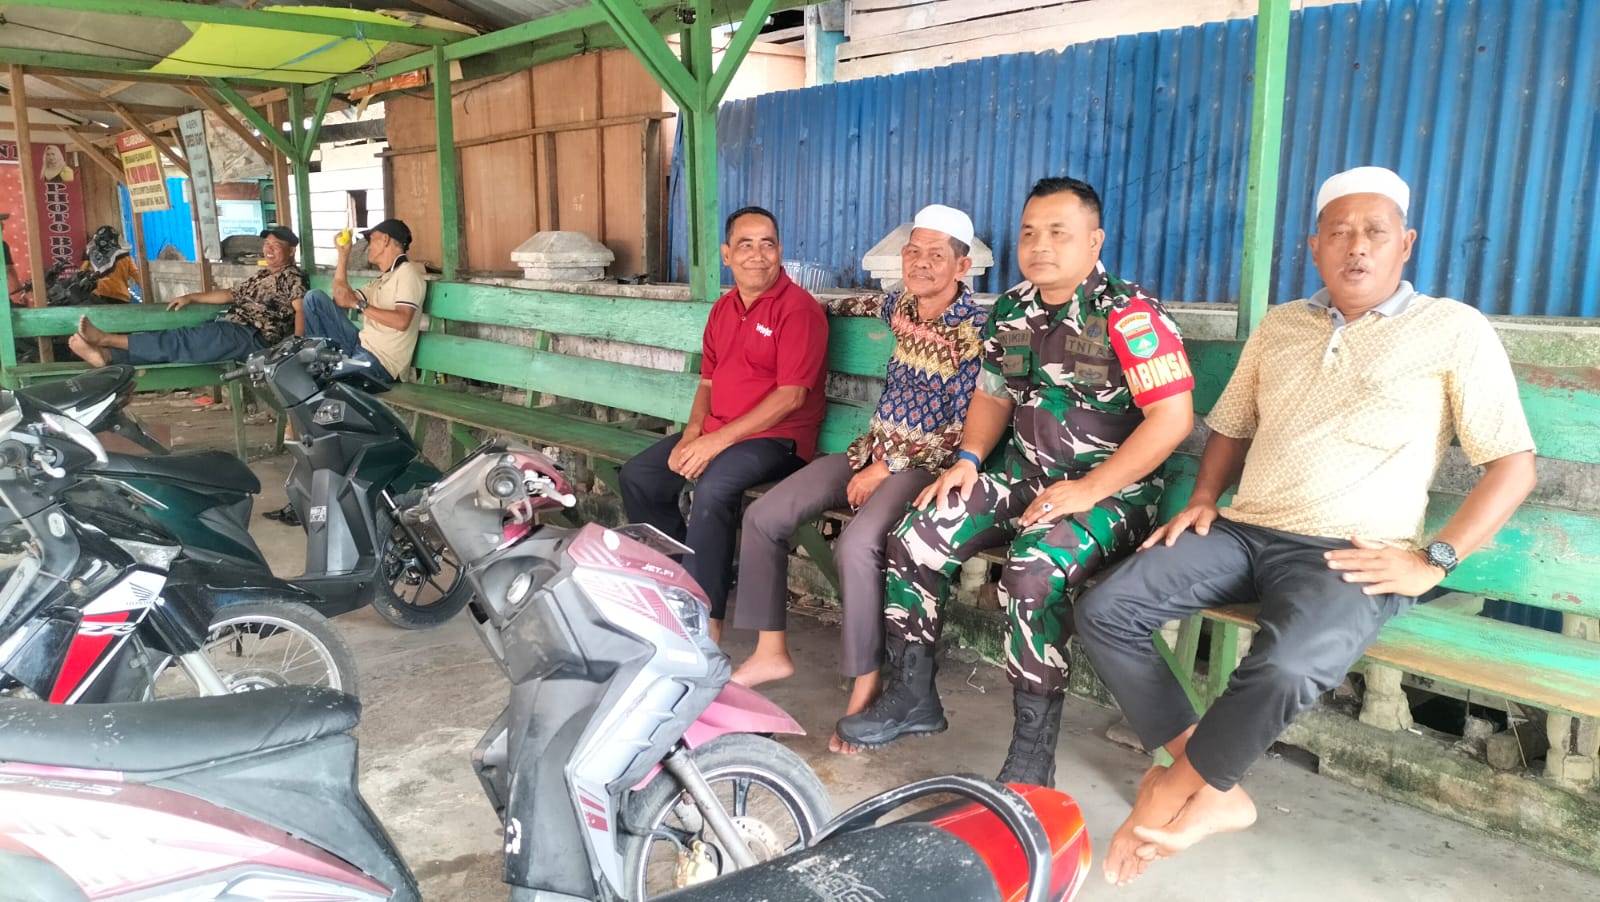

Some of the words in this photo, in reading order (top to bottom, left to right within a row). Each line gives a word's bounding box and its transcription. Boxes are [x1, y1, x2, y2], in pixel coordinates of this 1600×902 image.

[45, 183, 71, 233] PHOTO
[49, 236, 73, 266] BOX
[1067, 340, 1093, 355] TNI
